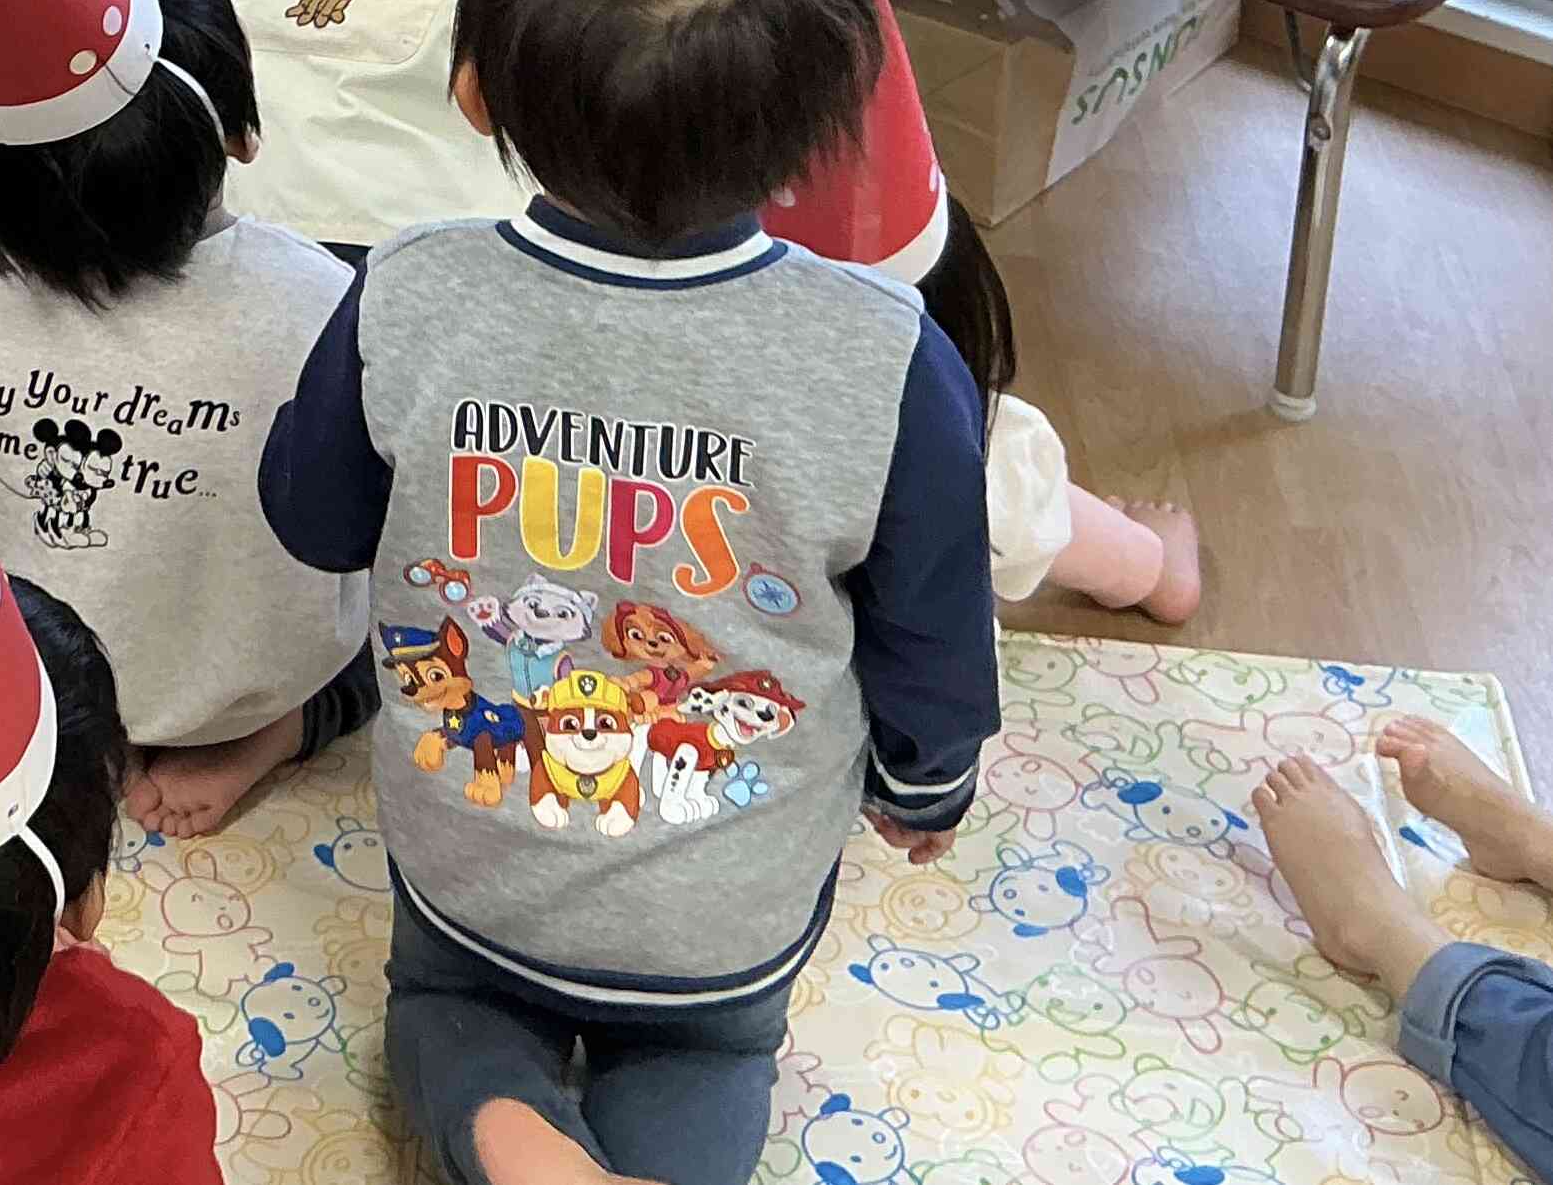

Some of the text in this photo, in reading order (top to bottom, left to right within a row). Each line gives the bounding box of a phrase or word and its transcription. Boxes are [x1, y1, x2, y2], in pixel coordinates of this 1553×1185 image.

[114, 385, 240, 436] dreams
[451, 398, 756, 488] ADVENTURE
[449, 453, 750, 598] PUPS
